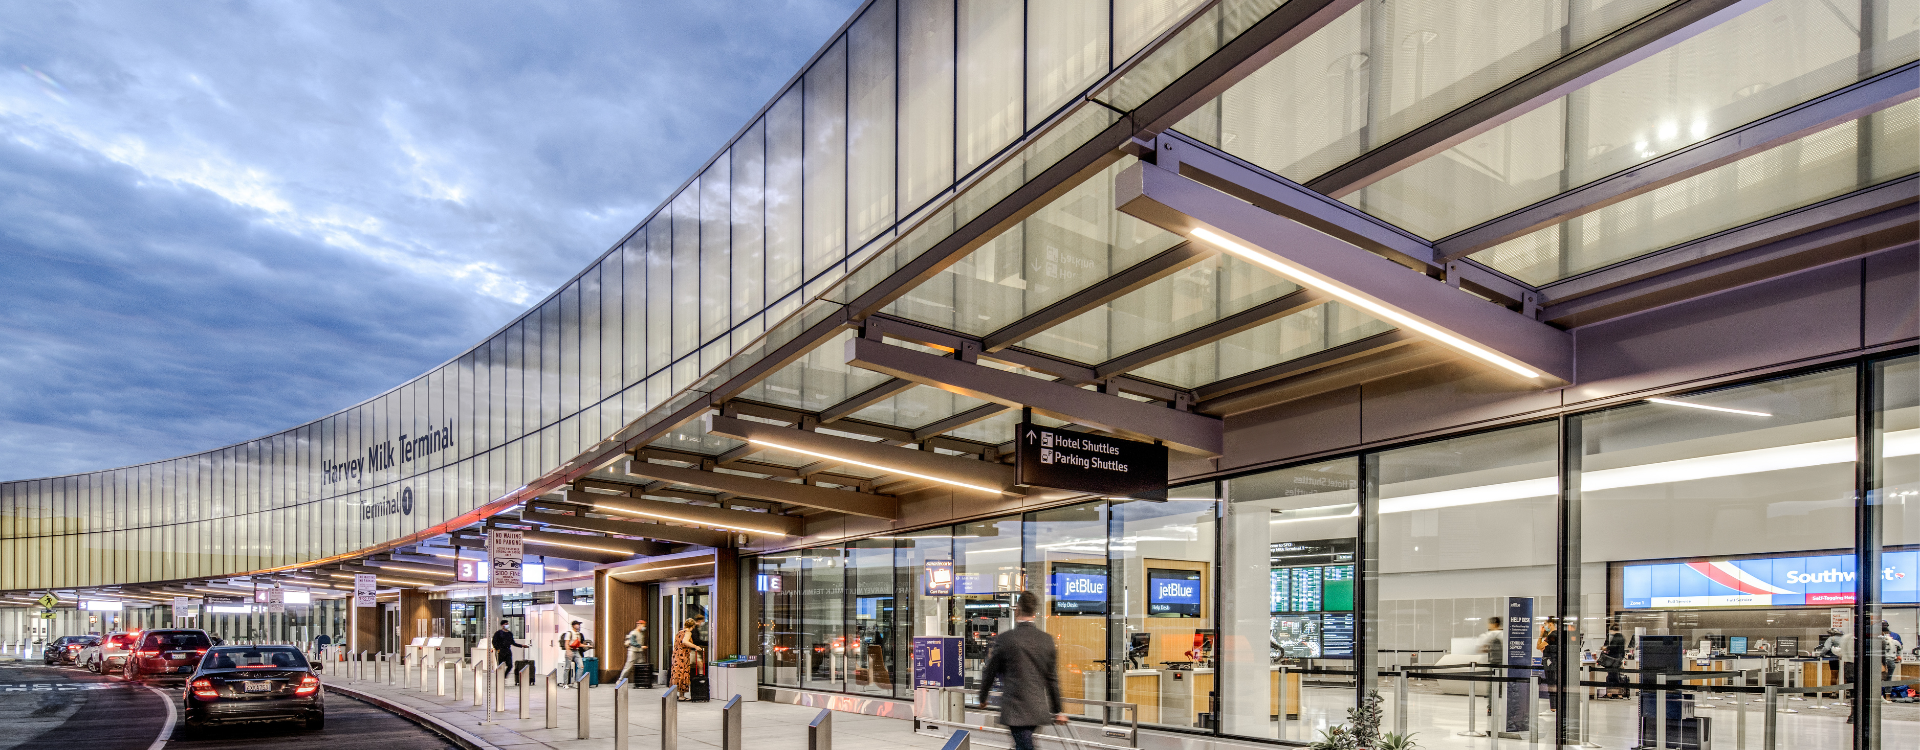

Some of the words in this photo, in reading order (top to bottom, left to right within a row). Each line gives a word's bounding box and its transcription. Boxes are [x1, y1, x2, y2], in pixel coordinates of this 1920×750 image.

[323, 457, 365, 485] Harvey
[368, 440, 395, 473] Milk
[399, 417, 454, 463] Terminal
[1055, 435, 1080, 449] Hotel
[1082, 440, 1120, 455] Shuttles
[1055, 452, 1090, 469] Parking
[1091, 457, 1128, 472] Shuttles
[361, 492, 400, 520] Terminal
[462, 563, 472, 577] 3
[1786, 567, 1894, 584] Southwt
[1065, 577, 1103, 595] jetBlue
[1158, 582, 1193, 599] jetBlue
[258, 592, 266, 600] 4
